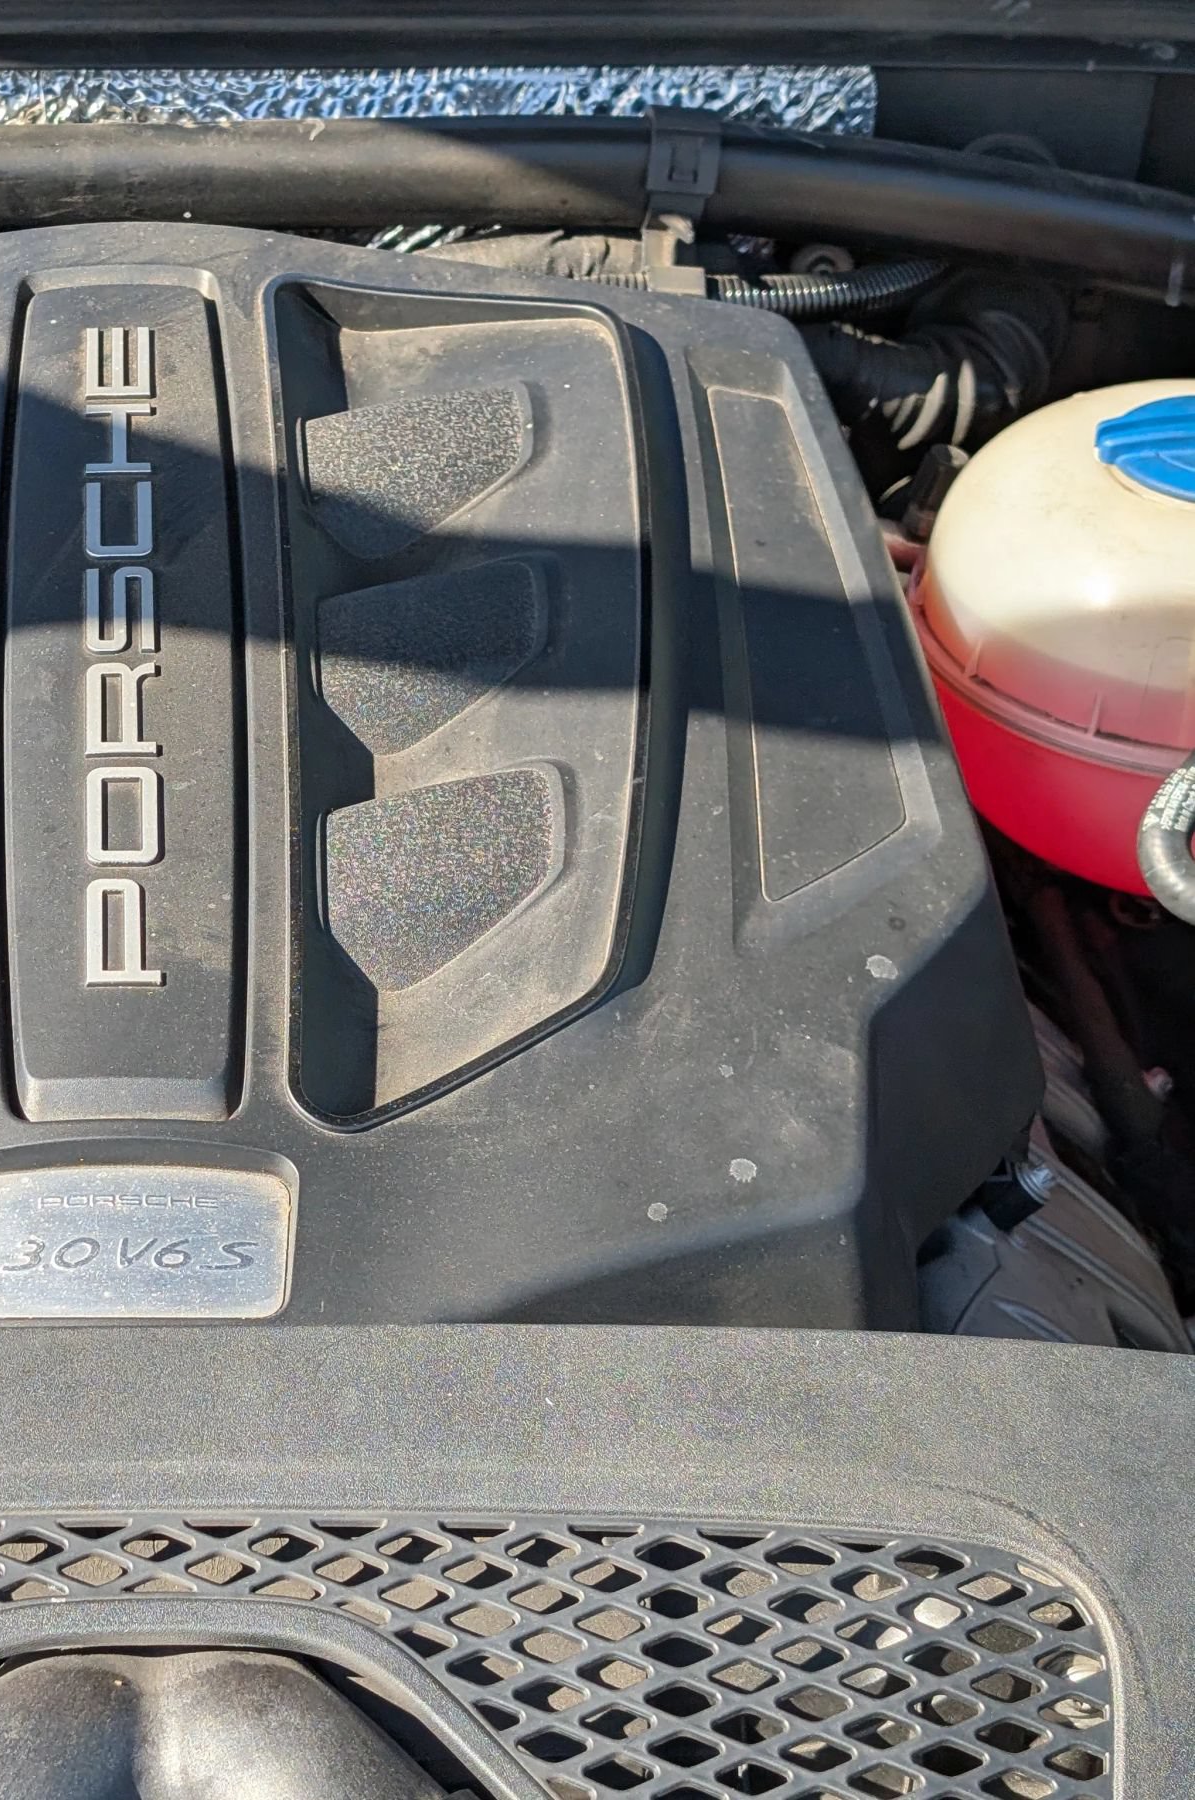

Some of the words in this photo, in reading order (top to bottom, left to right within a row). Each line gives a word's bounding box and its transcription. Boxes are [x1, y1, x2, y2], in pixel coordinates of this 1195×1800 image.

[85, 327, 163, 988] PORSCHE
[37, 1194, 219, 1210] PORSCHE
[117, 1237, 192, 1269] V6
[200, 1241, 260, 1270] S
